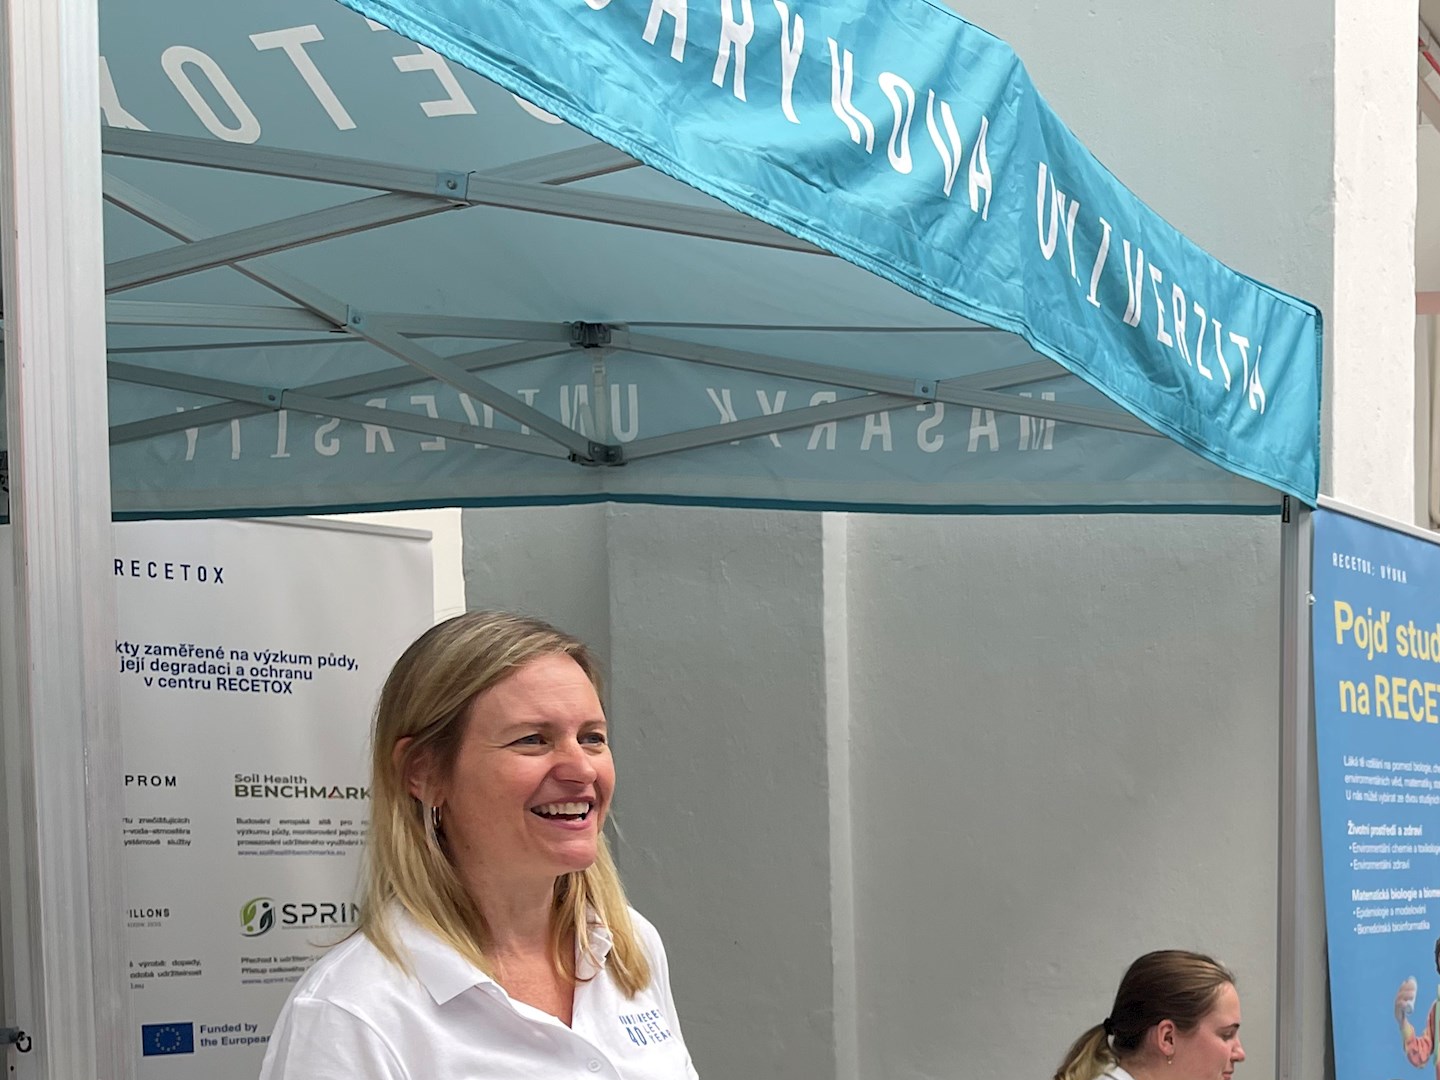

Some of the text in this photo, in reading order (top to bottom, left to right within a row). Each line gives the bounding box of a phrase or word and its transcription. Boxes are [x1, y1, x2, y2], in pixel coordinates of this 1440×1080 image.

[586, 0, 992, 221] ARYKOVA
[1037, 161, 1267, 414] UNIVERZITA
[113, 558, 225, 585] RECETOX
[1333, 600, 1390, 662] Pojď
[120, 656, 312, 680] její degradaci a ochranu
[144, 643, 224, 660] zaměřené
[230, 649, 248, 661] na
[253, 649, 312, 665] výzkum
[317, 653, 359, 670] půdy,
[144, 676, 292, 694] v centru RECETOX
[1339, 679, 1370, 715] na
[234, 774, 307, 785] Soil Health
[127, 908, 170, 918] ILLONS
[200, 1022, 258, 1034] Funded by
[626, 1026, 647, 1047] 40
[200, 1037, 217, 1047] the
